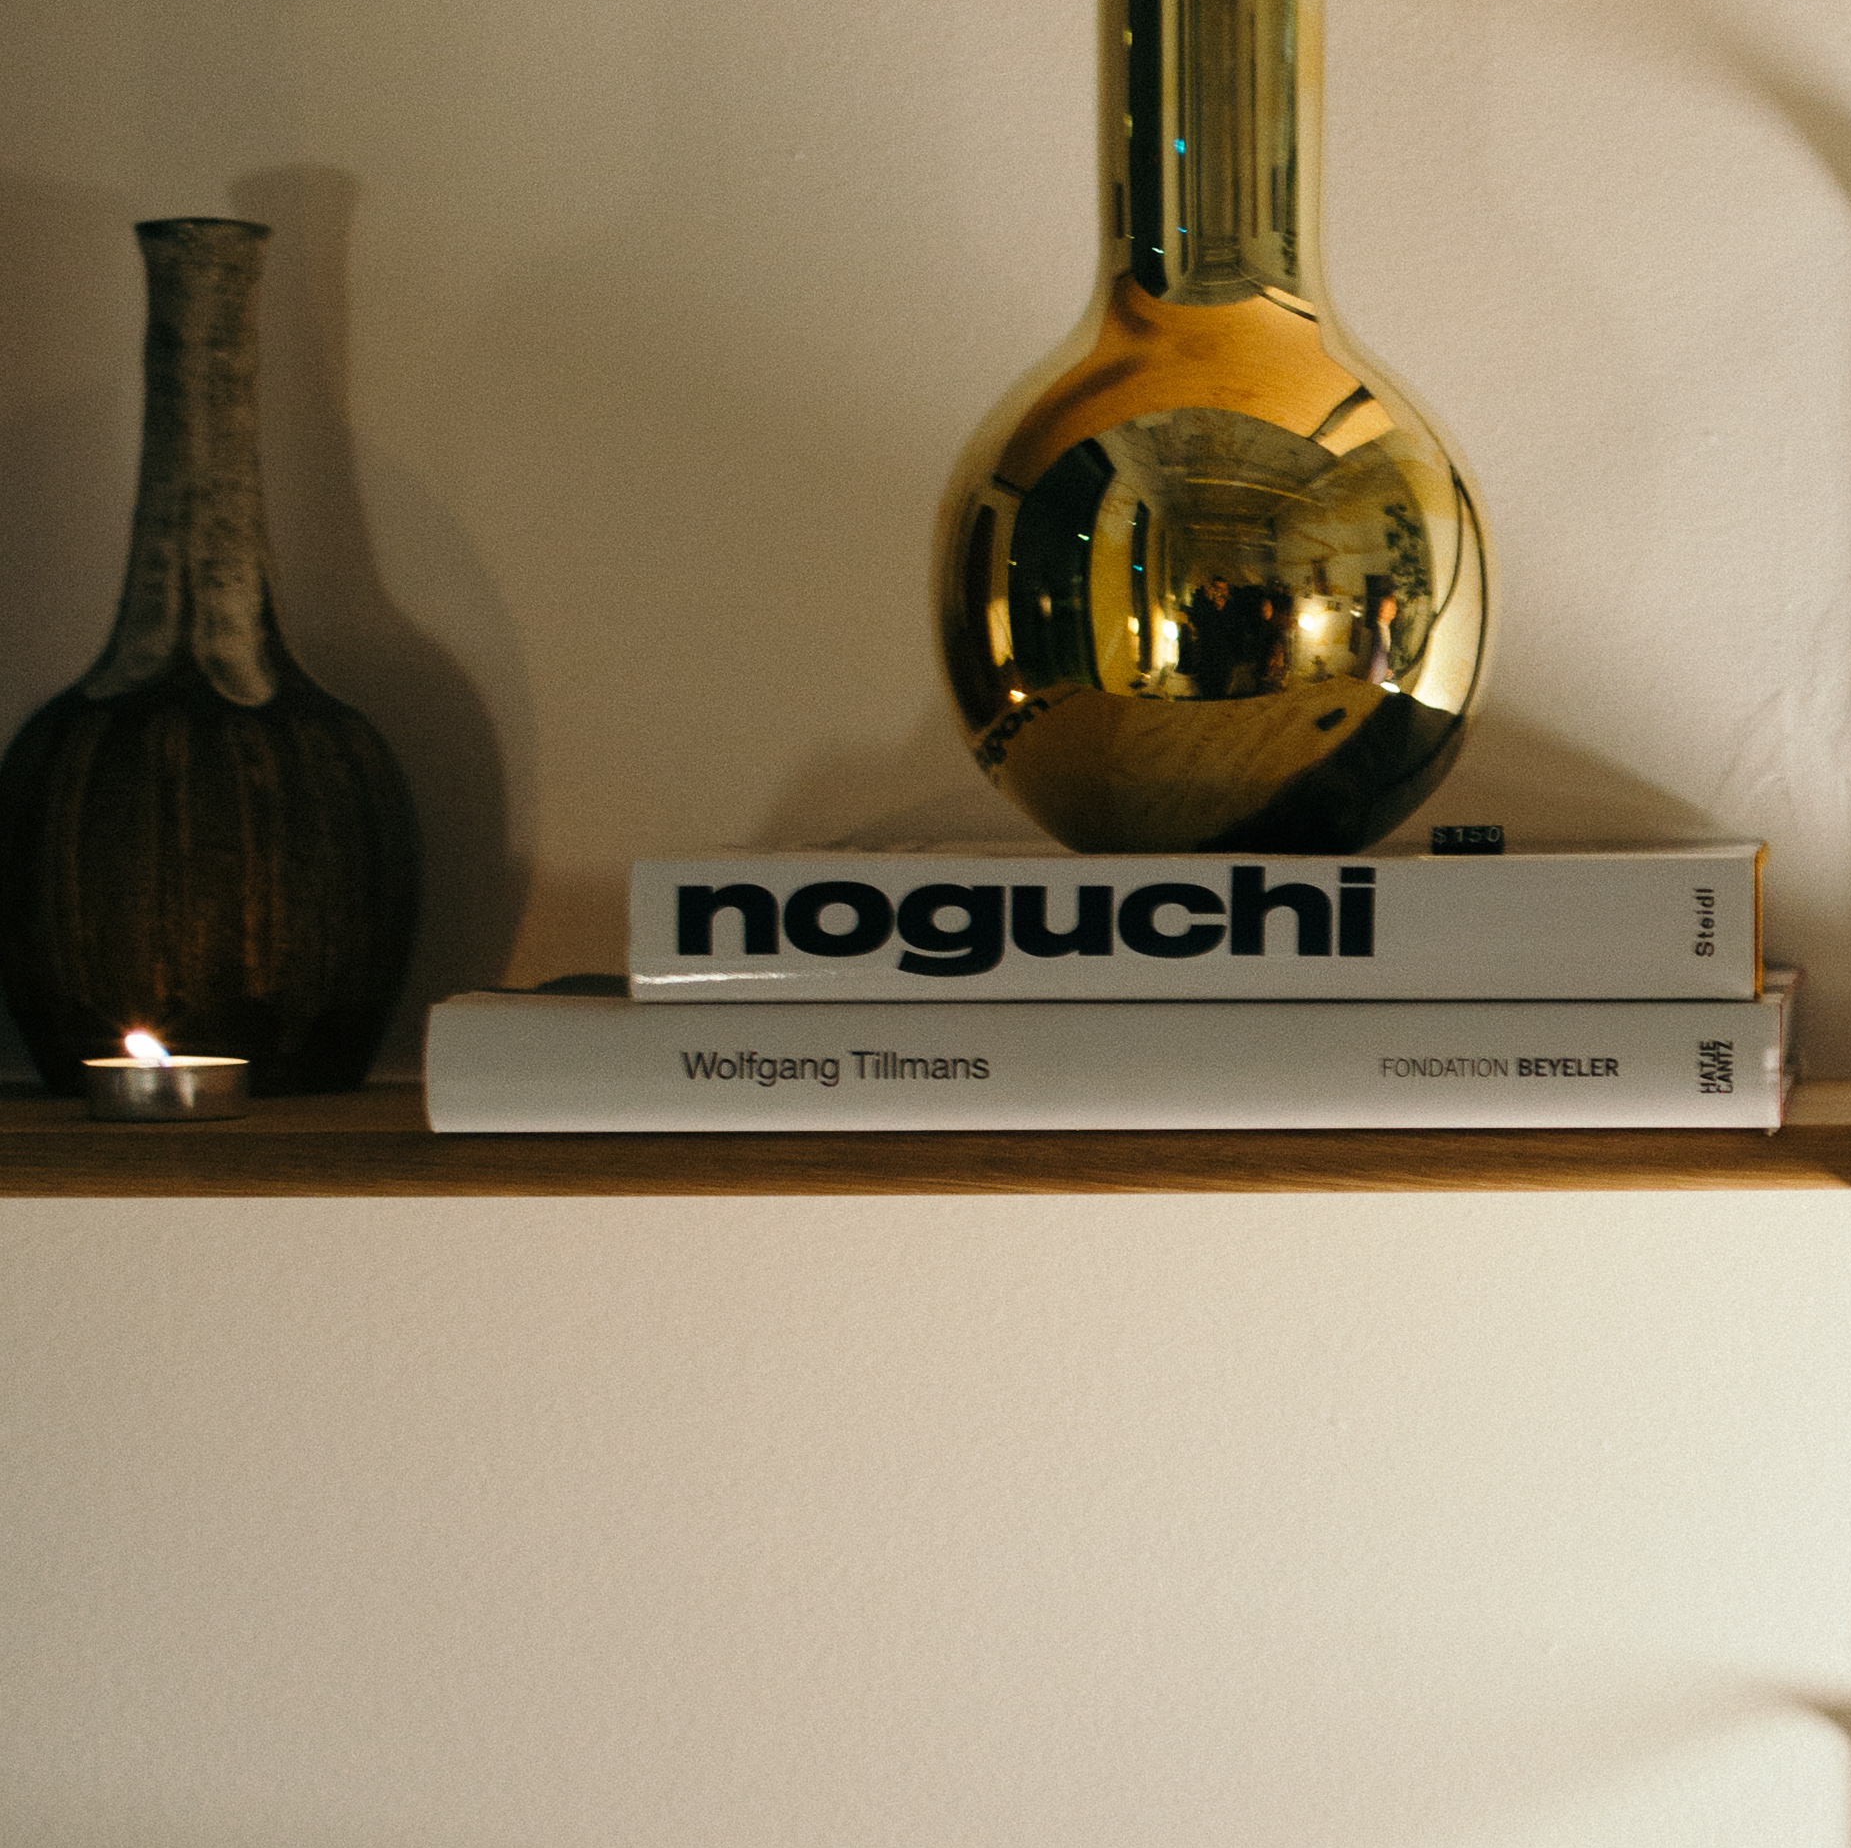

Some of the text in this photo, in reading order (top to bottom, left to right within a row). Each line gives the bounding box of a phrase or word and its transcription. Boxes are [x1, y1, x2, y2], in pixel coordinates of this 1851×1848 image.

[677, 865, 1377, 978] noguchi
[1694, 887, 1716, 958] Steidl
[681, 1050, 991, 1088] Wolfgang Tillmans
[1381, 1057, 1620, 1078] FONDATION BEYELER
[1699, 1040, 1718, 1094] HATJE
[1716, 1040, 1735, 1094] CANTZ
